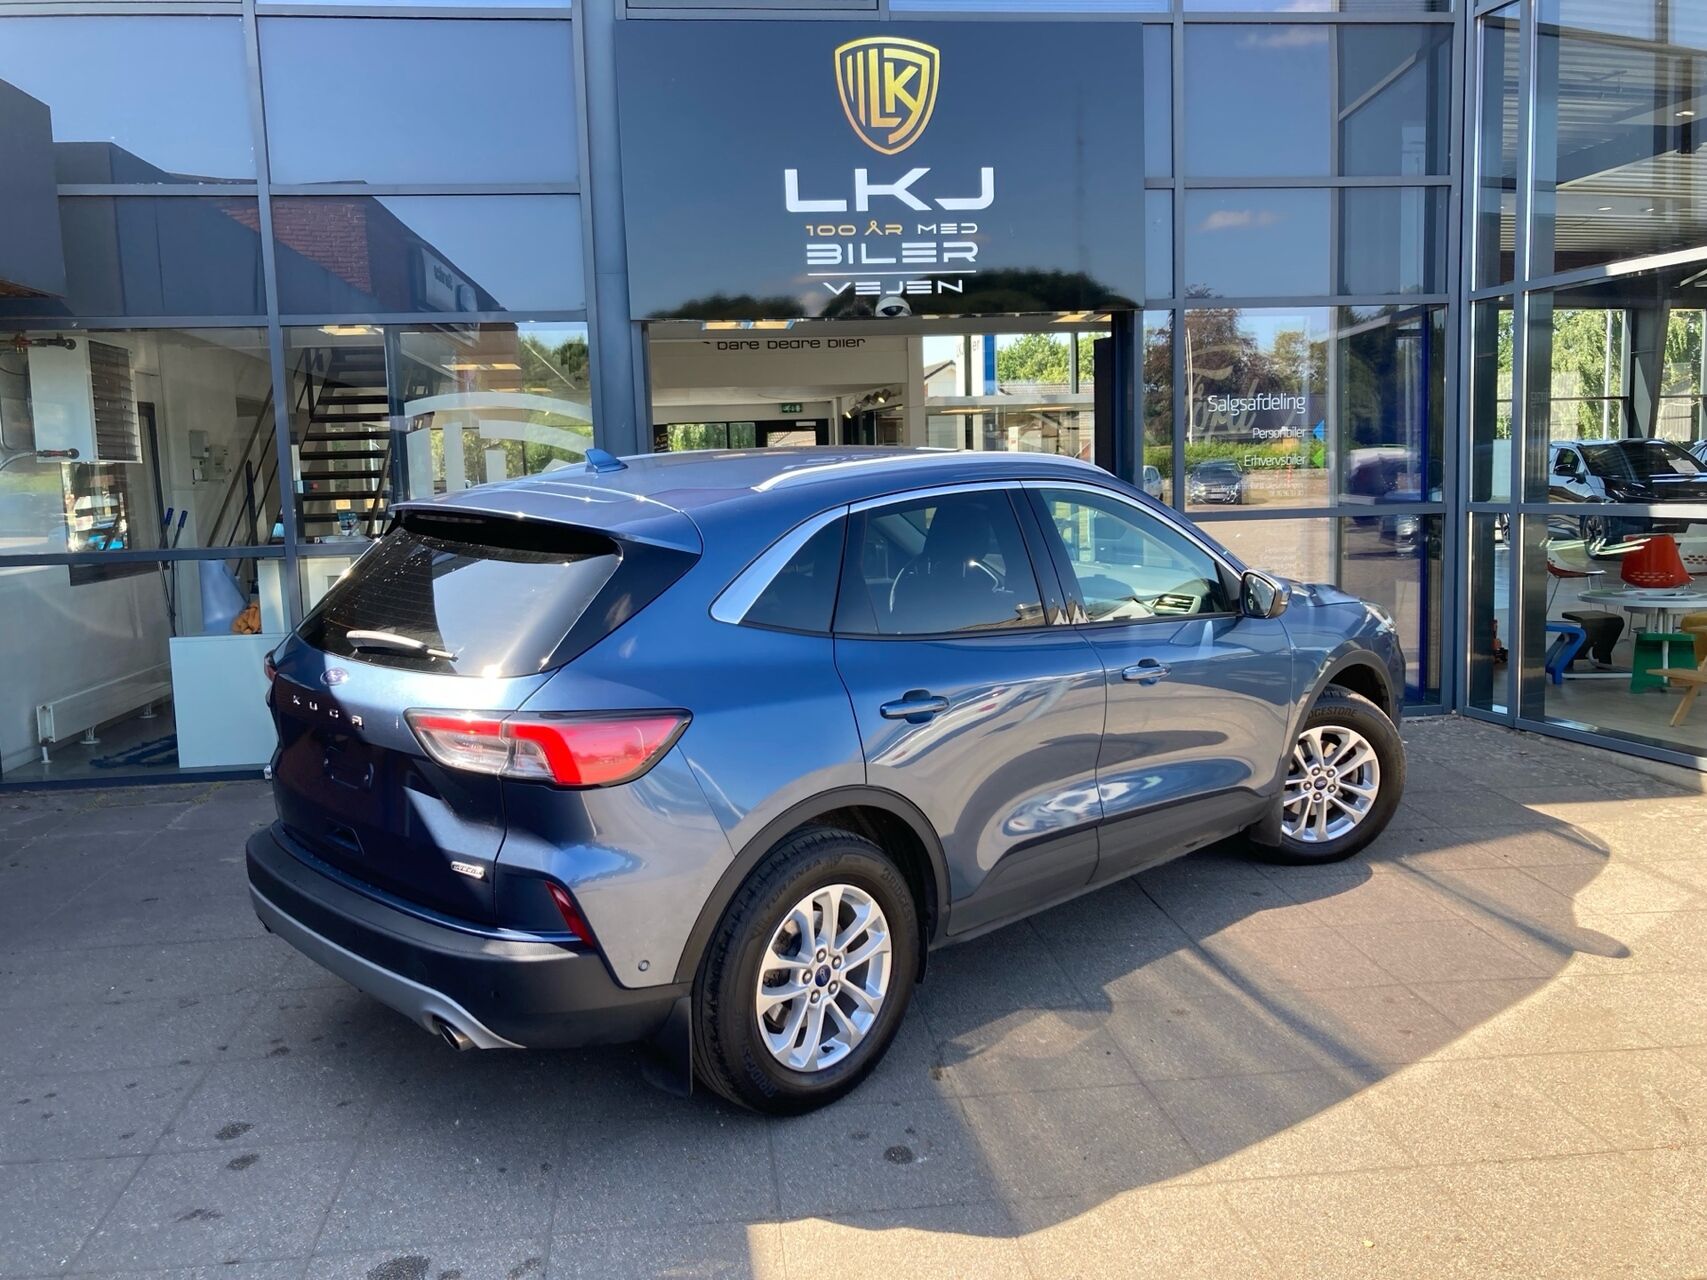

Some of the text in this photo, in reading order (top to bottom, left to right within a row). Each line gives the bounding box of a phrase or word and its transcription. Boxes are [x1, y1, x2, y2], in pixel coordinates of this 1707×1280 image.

[784, 166, 995, 213] LKJ
[805, 219, 978, 237] 100 ÅR MED
[806, 241, 979, 265] BILER
[822, 278, 963, 296] VEJEN
[1207, 392, 1306, 416] Salgsafdeling
[1252, 426, 1306, 440] Personbiler
[1244, 454, 1306, 467] Erhvervsbiler
